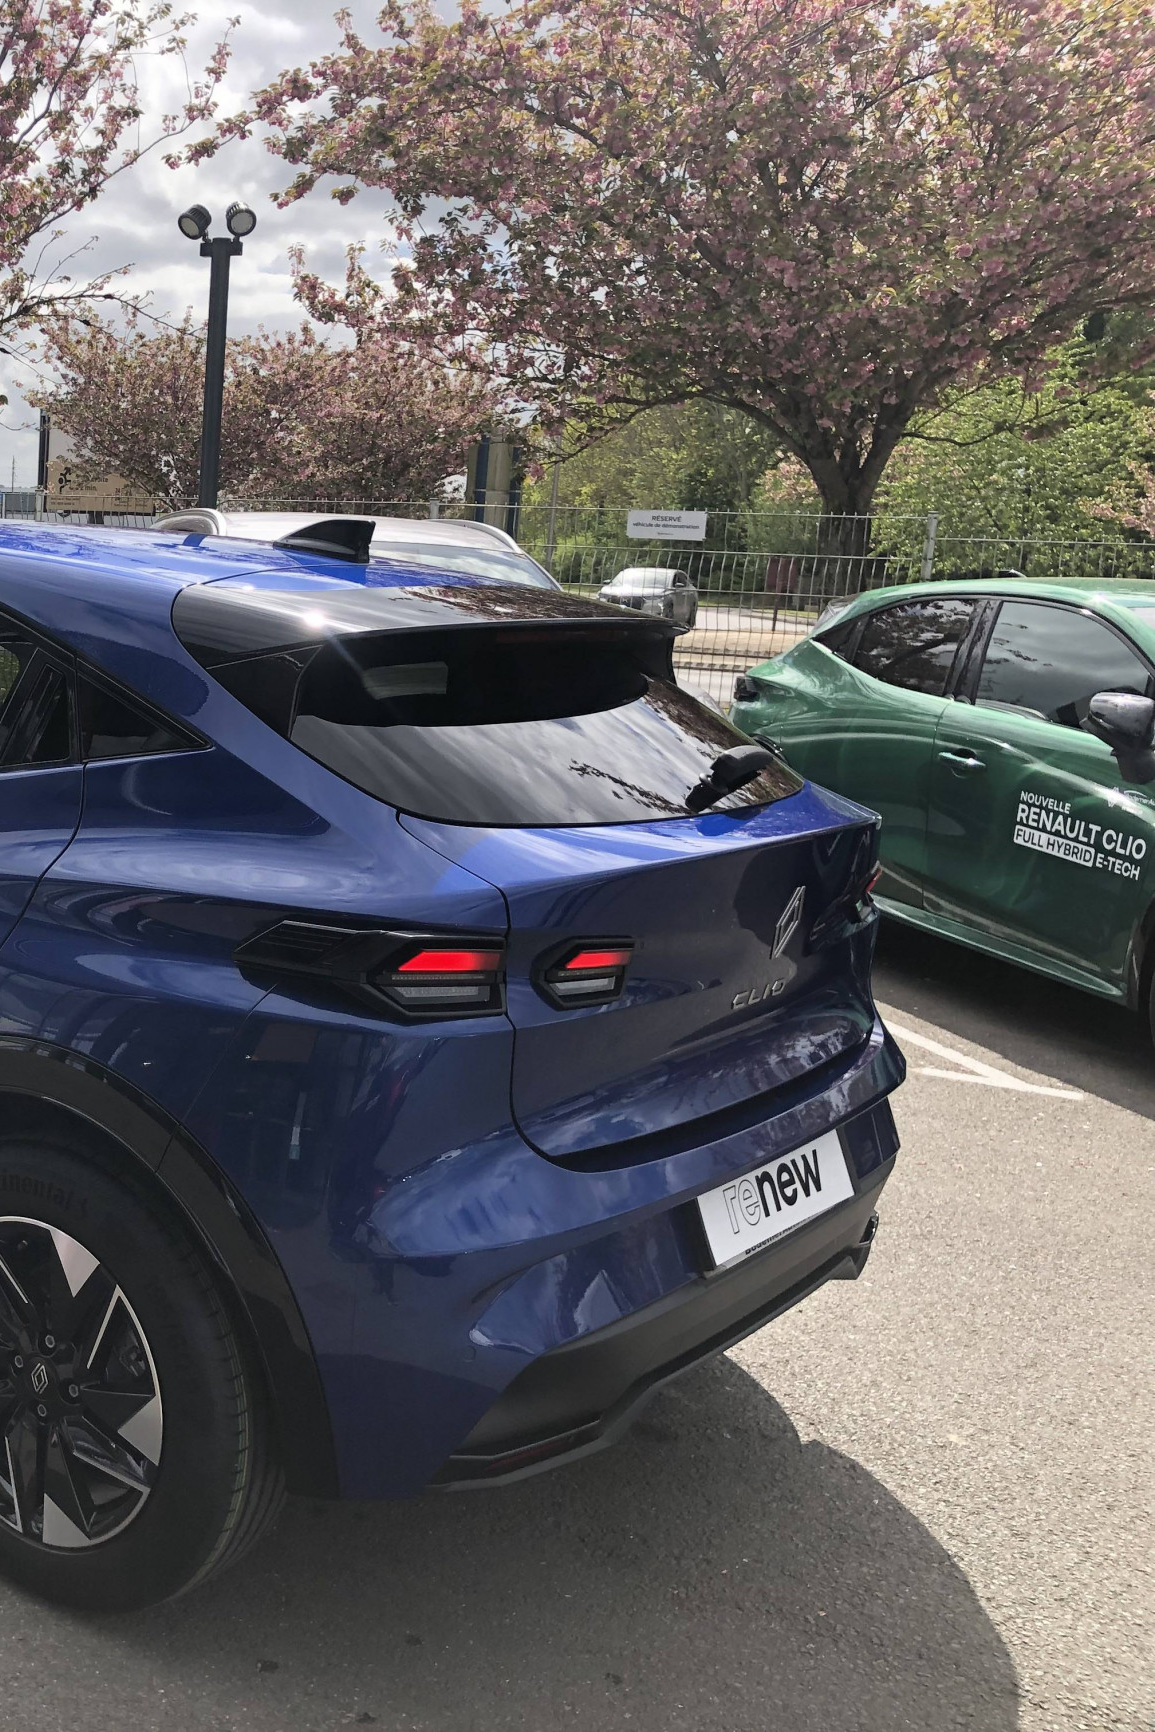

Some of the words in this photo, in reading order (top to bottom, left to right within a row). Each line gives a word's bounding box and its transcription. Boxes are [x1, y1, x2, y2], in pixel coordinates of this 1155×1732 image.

[1020, 791, 1072, 814] NOUVELLE
[1016, 803, 1101, 845] RENAULT
[1102, 829, 1147, 860] CLIO
[1016, 828, 1043, 848] FULL
[1046, 838, 1093, 863] HYBRID
[1096, 853, 1141, 880] E-TECH
[731, 977, 786, 1009] CLIO
[722, 1149, 822, 1235] renew
